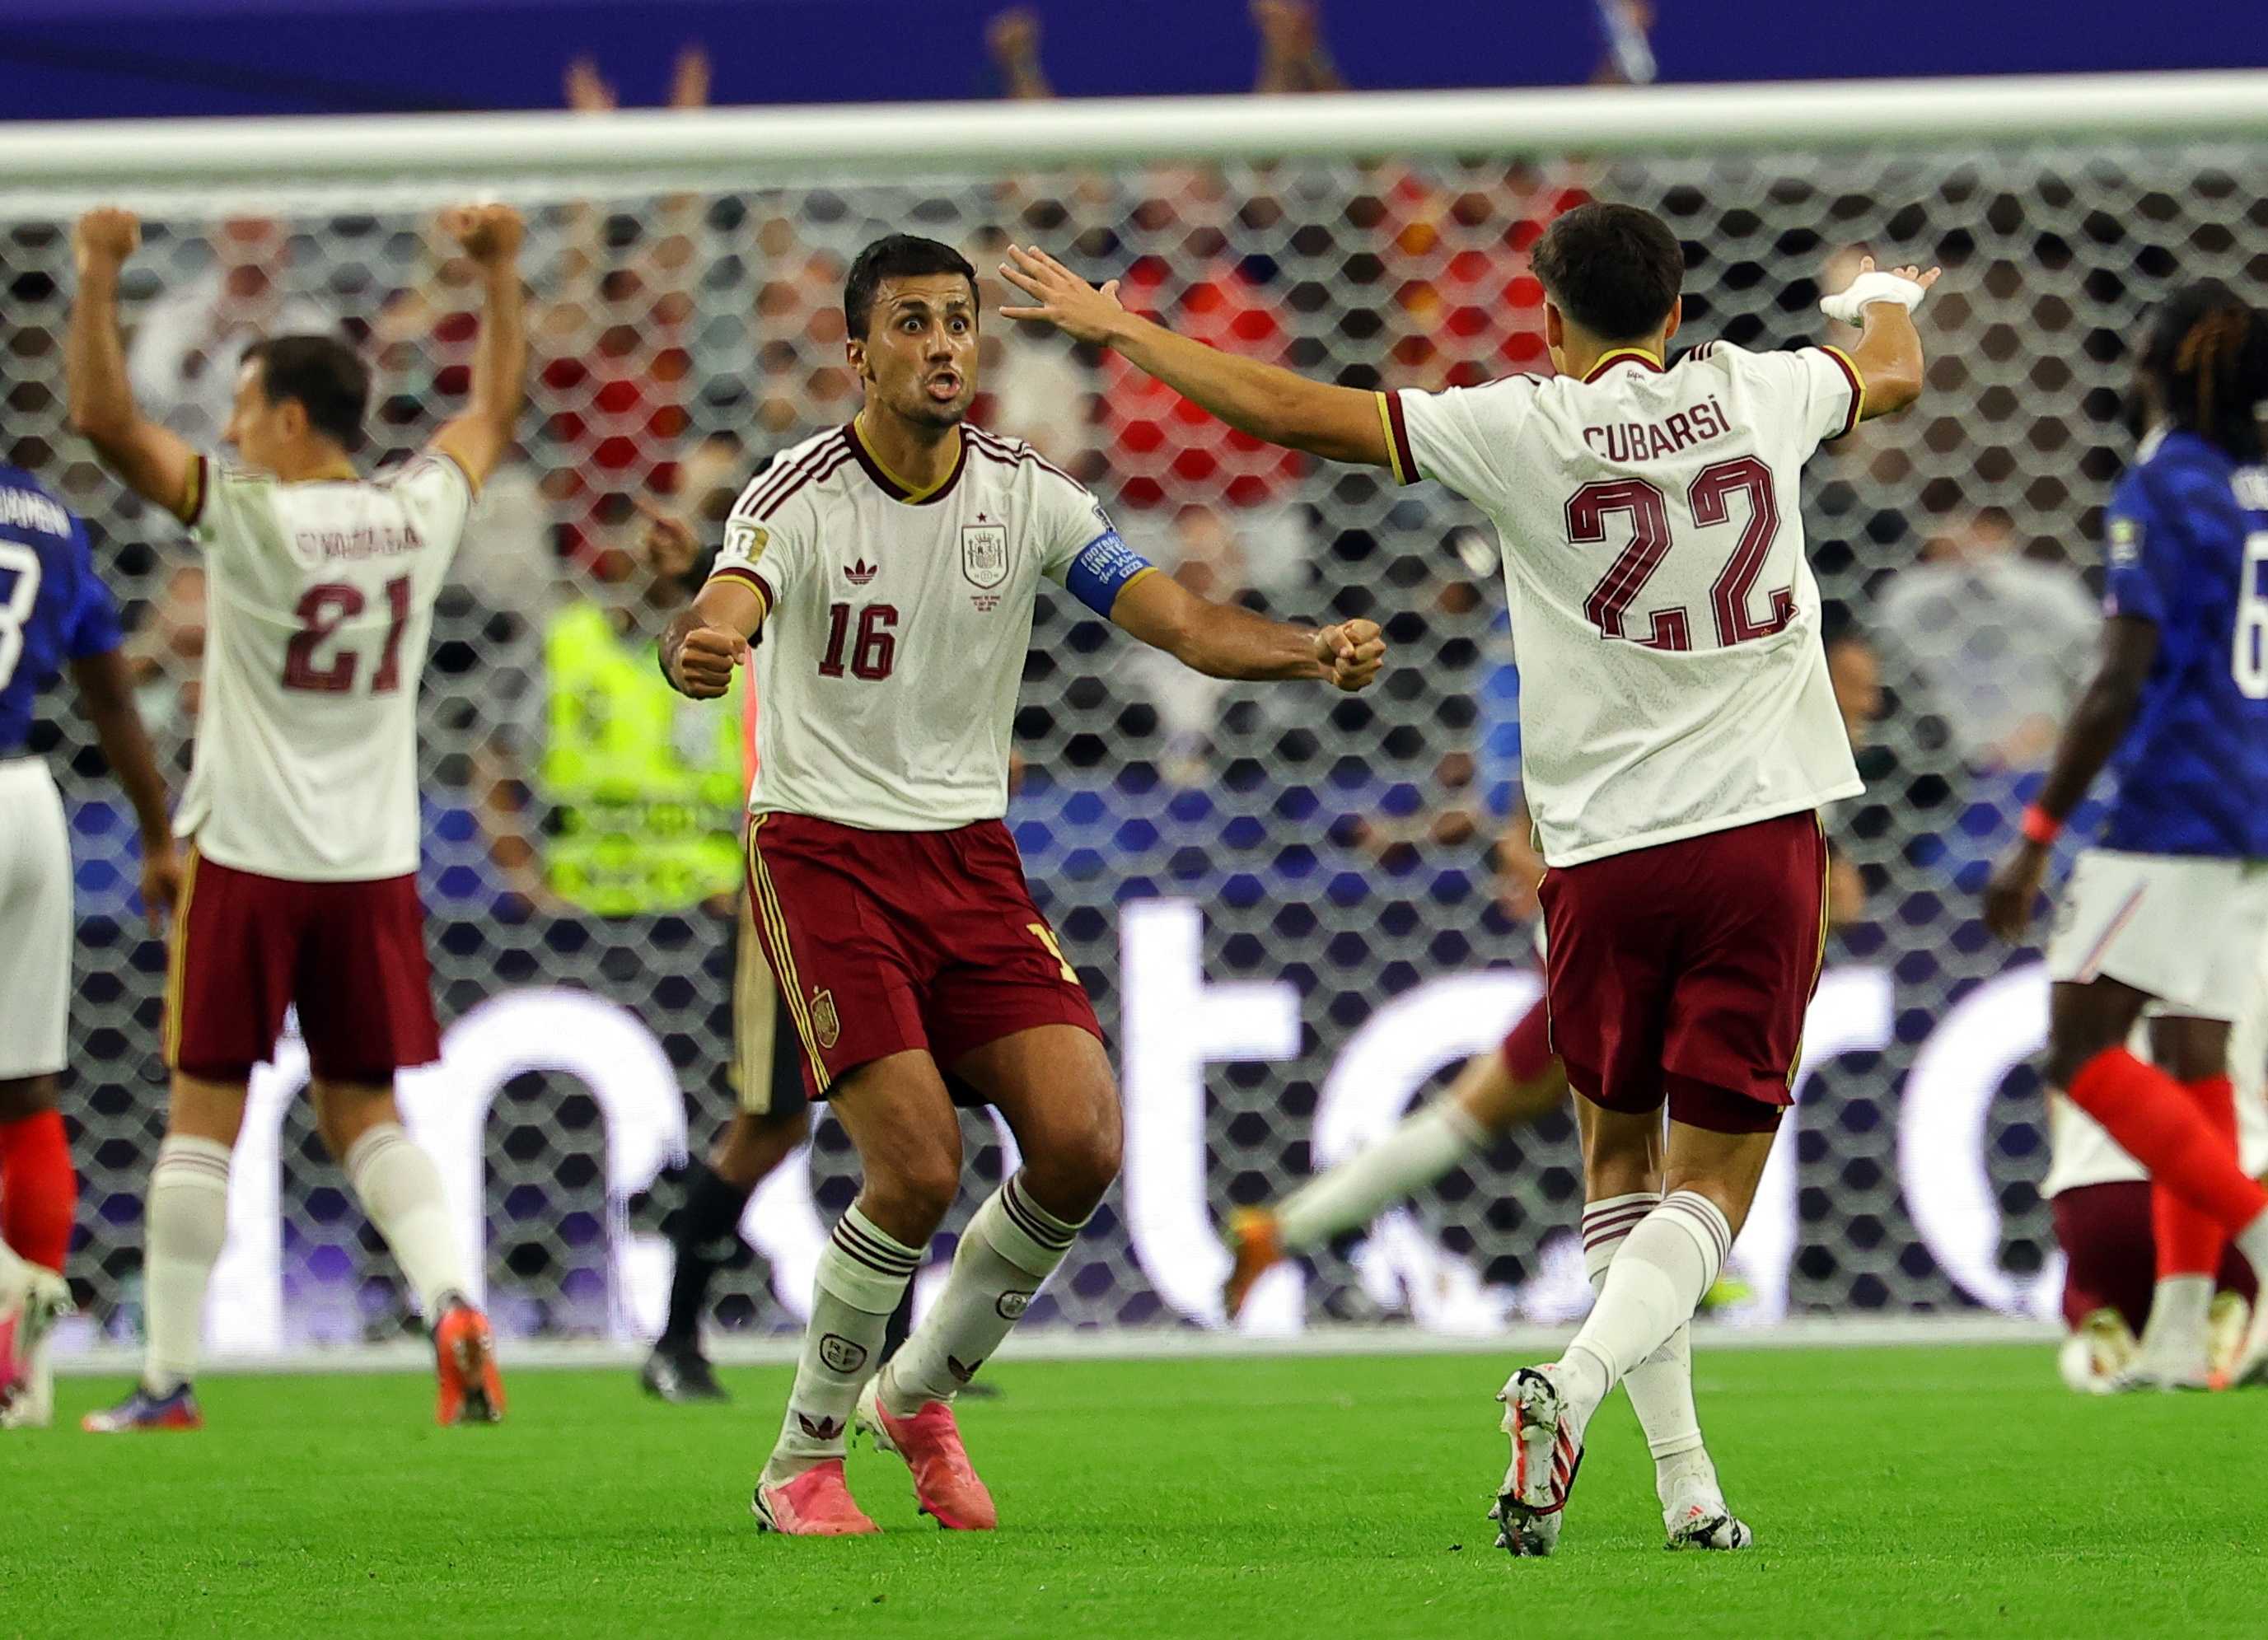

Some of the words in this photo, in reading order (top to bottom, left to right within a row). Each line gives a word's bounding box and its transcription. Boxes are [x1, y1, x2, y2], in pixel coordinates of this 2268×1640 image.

[1583, 394, 1732, 463] CUBARSÍ
[1080, 535, 1123, 568] FOOTBAL
[1087, 543, 1129, 576] UNITE
[1564, 454, 1800, 652] 22
[283, 576, 413, 697] 21
[818, 602, 899, 682] 16
